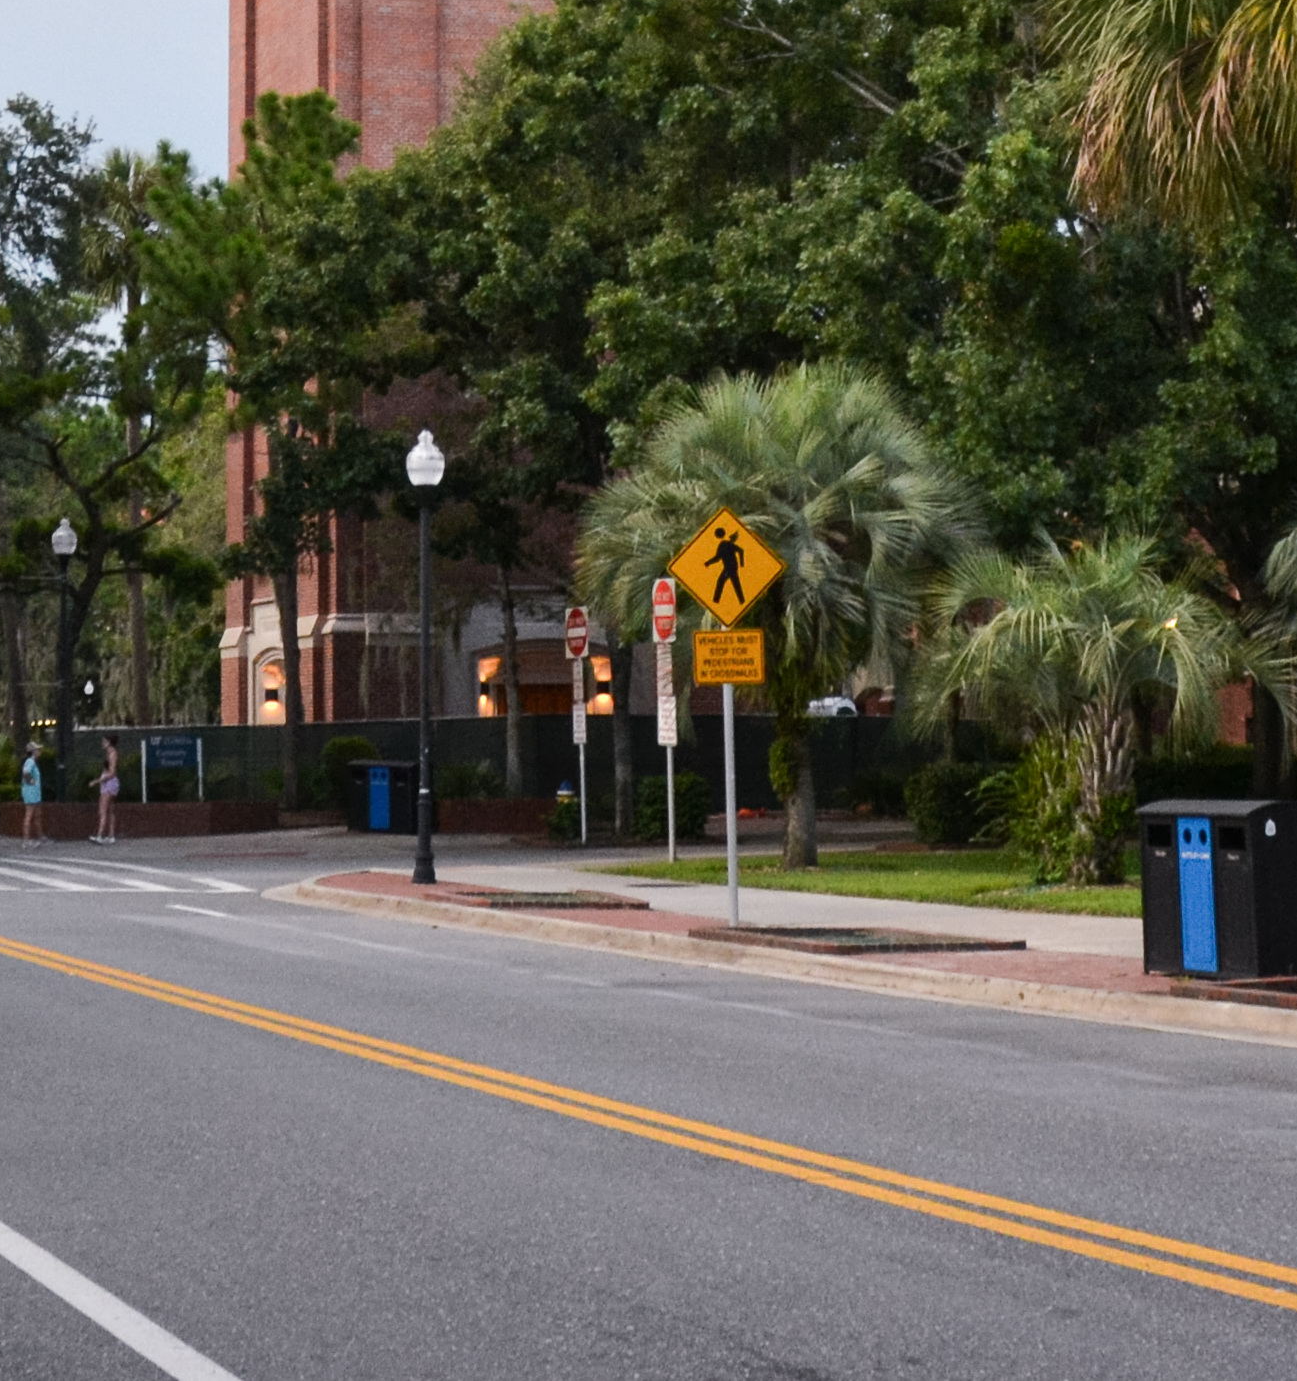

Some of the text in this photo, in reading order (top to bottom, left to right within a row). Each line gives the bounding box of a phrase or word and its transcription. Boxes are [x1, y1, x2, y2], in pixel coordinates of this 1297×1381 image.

[699, 635, 759, 645] VEHICLES MUST
[709, 647, 748, 656] STOP FOR
[703, 658, 755, 667] PEDESTRIANS
[710, 669, 759, 678] CROSSWALKS
